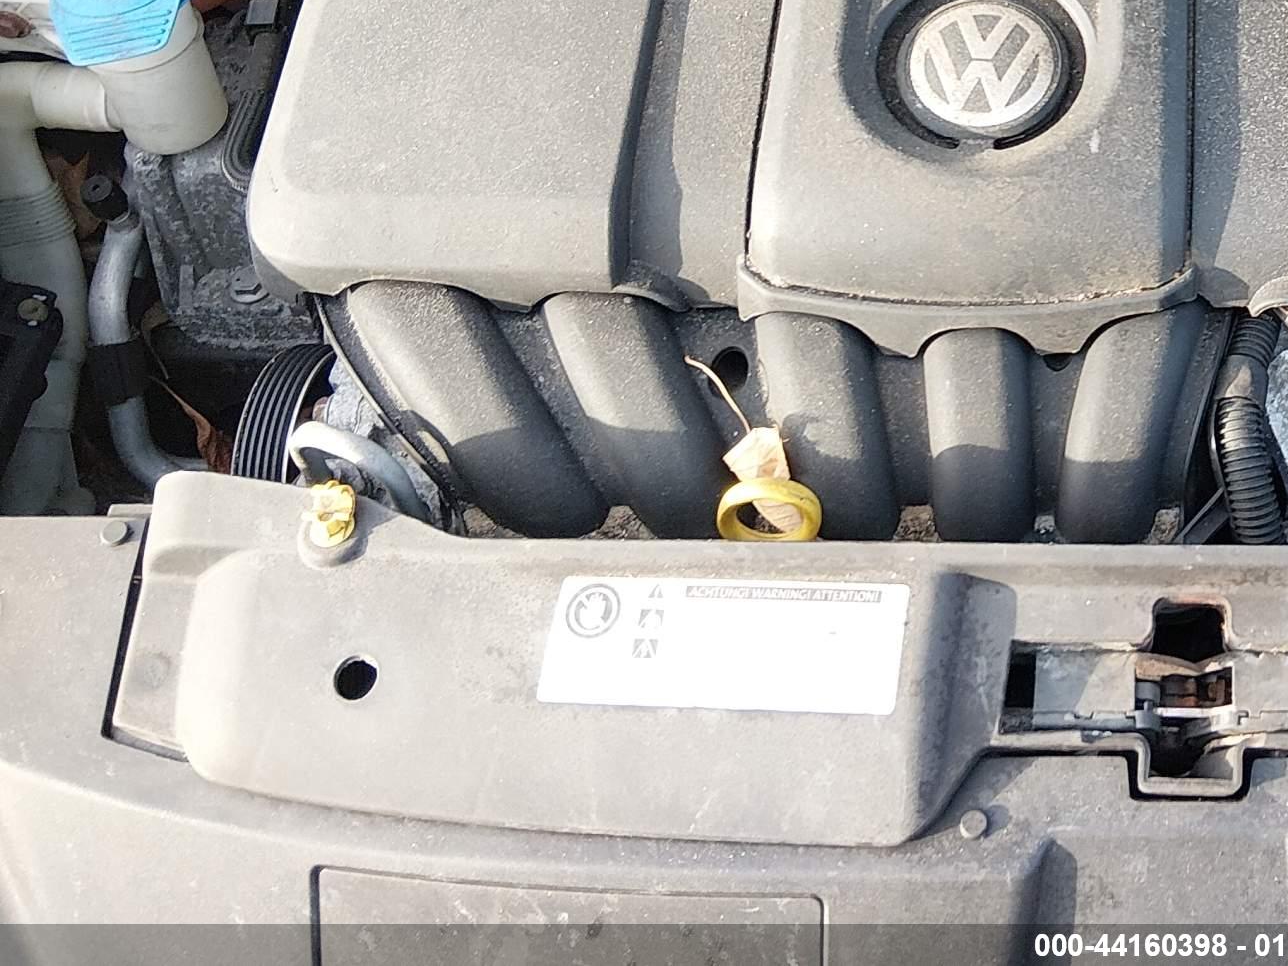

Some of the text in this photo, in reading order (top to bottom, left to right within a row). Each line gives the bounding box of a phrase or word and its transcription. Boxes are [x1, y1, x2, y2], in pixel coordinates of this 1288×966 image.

[689, 586, 880, 602] ACHTUNG! WARNING! ATTENTION!
